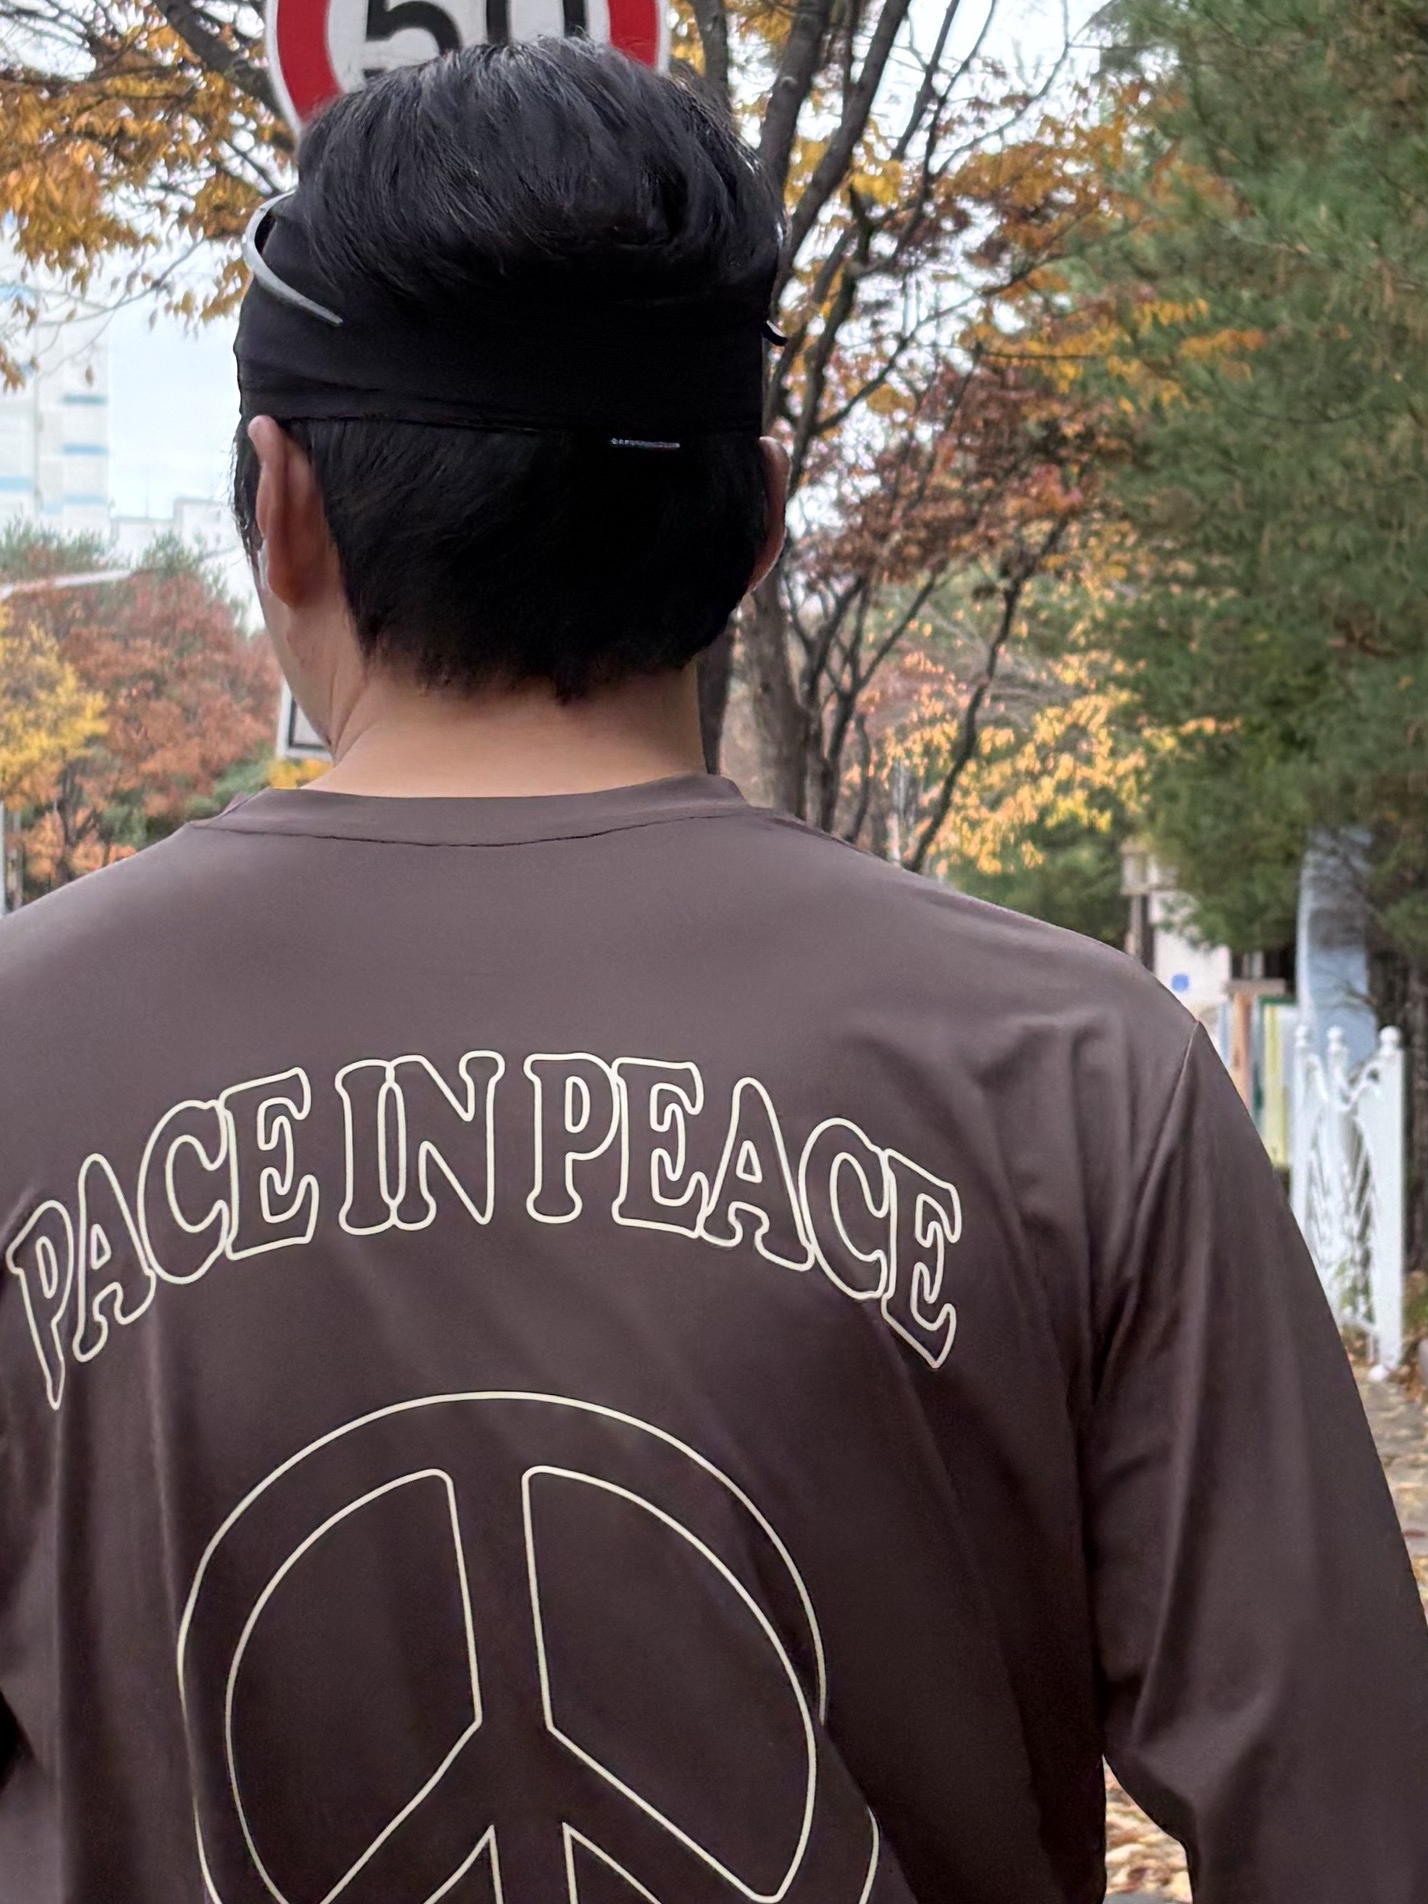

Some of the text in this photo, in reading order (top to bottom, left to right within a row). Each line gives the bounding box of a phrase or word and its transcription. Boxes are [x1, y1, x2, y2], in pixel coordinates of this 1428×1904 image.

[6, 1050, 962, 1411] PACE IN PEACE
